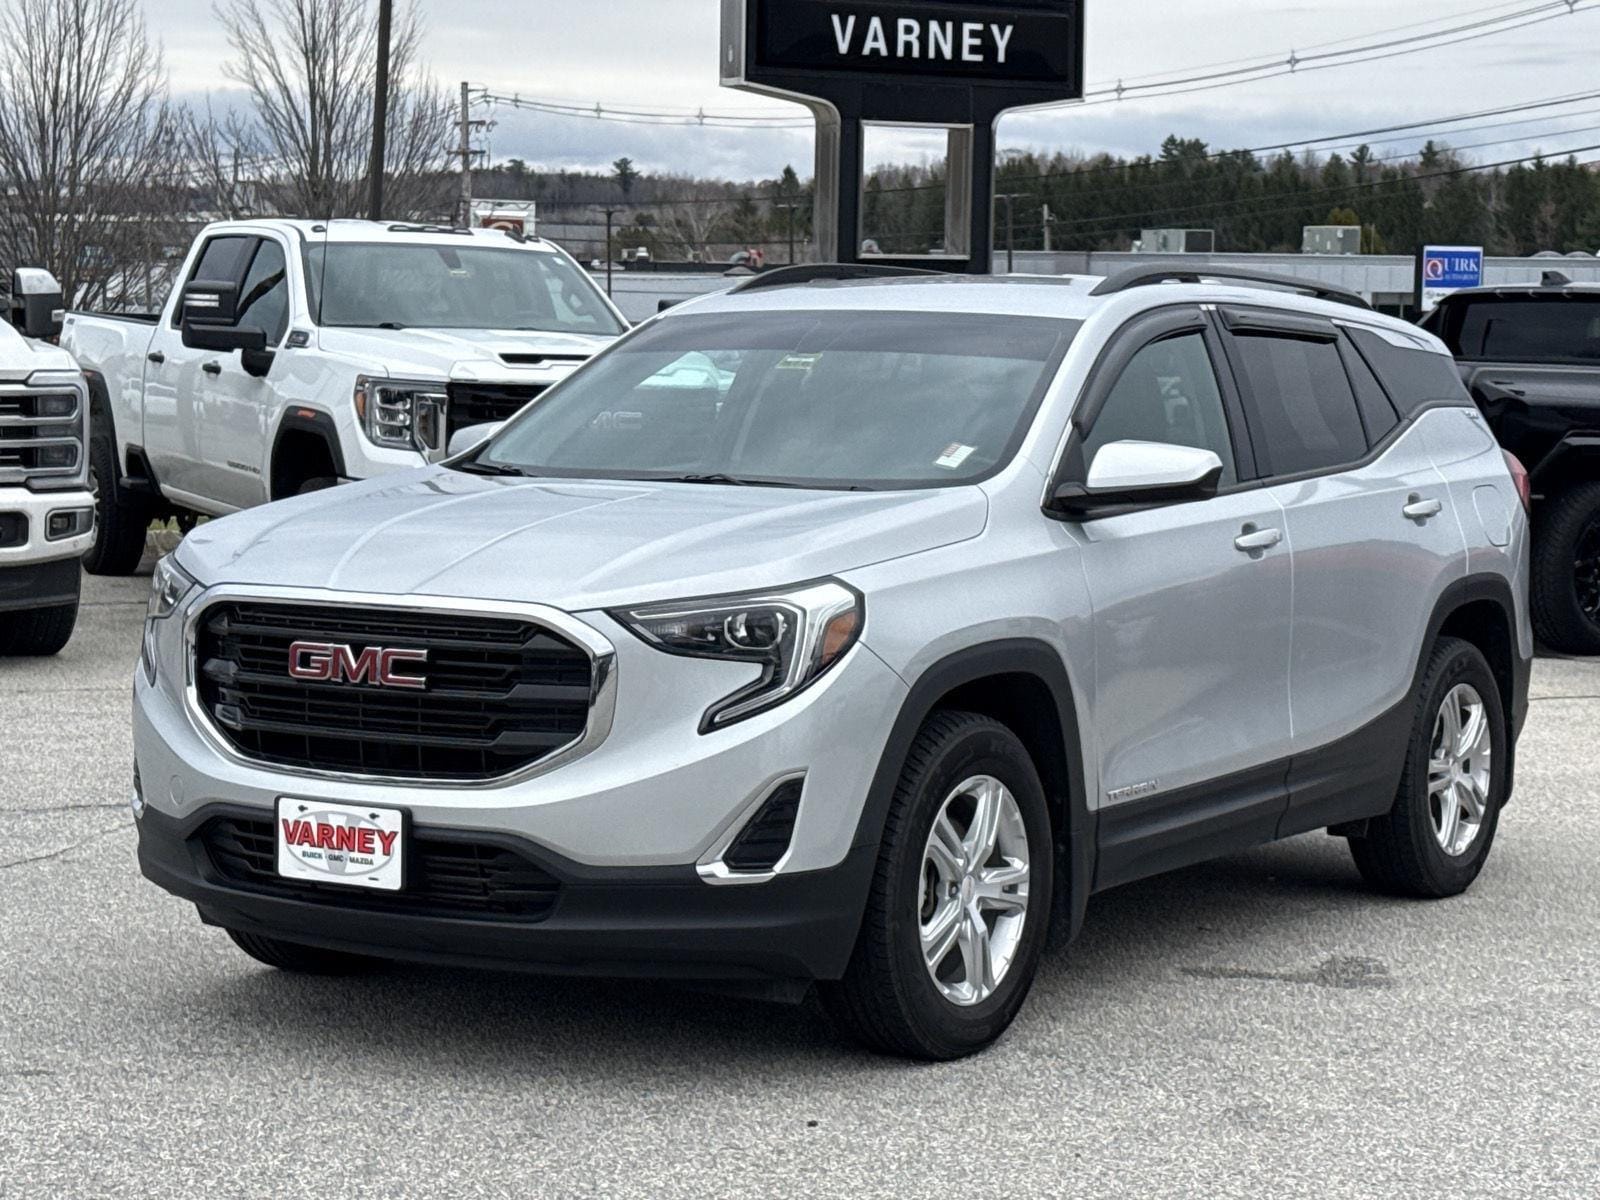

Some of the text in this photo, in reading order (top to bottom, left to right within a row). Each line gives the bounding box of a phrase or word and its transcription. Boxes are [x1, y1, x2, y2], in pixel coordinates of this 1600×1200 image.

[830, 14, 1014, 63] VARNEY
[288, 641, 428, 689] GMC
[282, 819, 399, 856] VARNEY
[302, 850, 374, 866] BUICK GMC MAZDA
